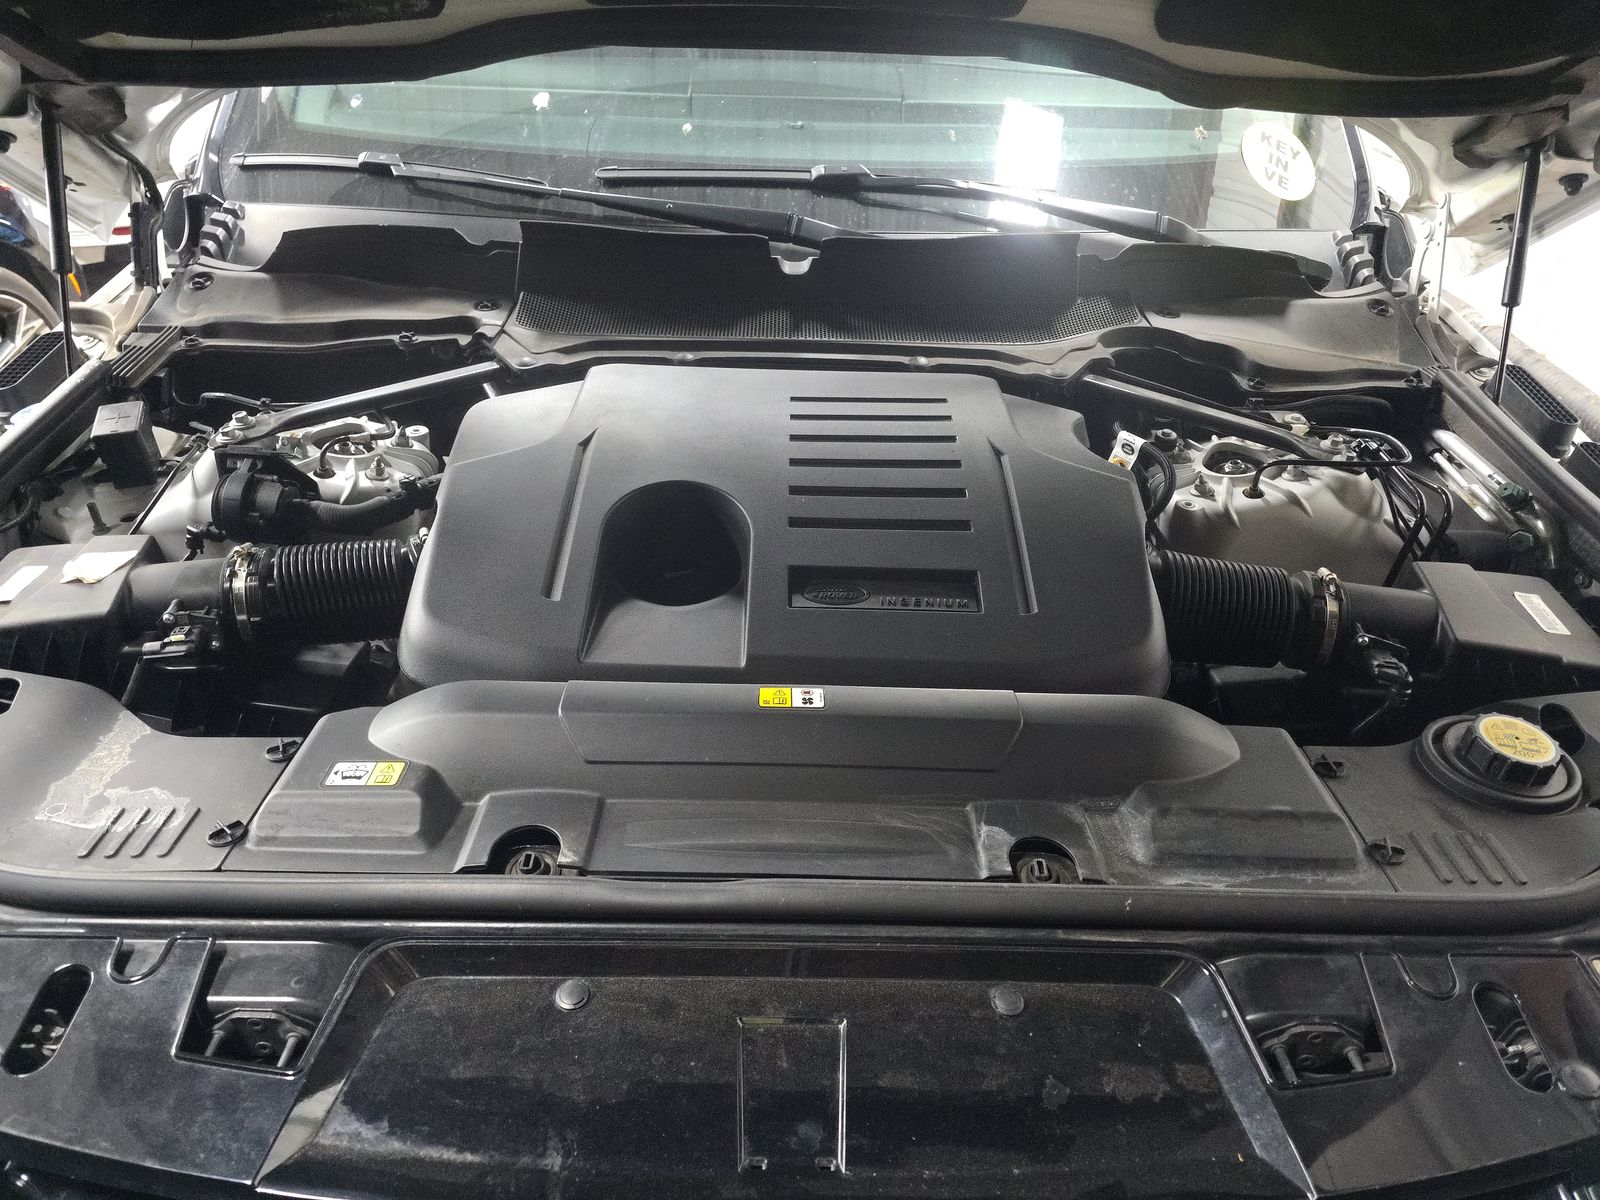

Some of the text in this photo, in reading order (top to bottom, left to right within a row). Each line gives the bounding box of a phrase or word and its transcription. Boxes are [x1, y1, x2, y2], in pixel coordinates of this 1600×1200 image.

[1260, 131, 1301, 161] KEY
[1268, 153, 1289, 173] IN
[1264, 166, 1290, 191] VE
[880, 596, 969, 609] INGENIUM
